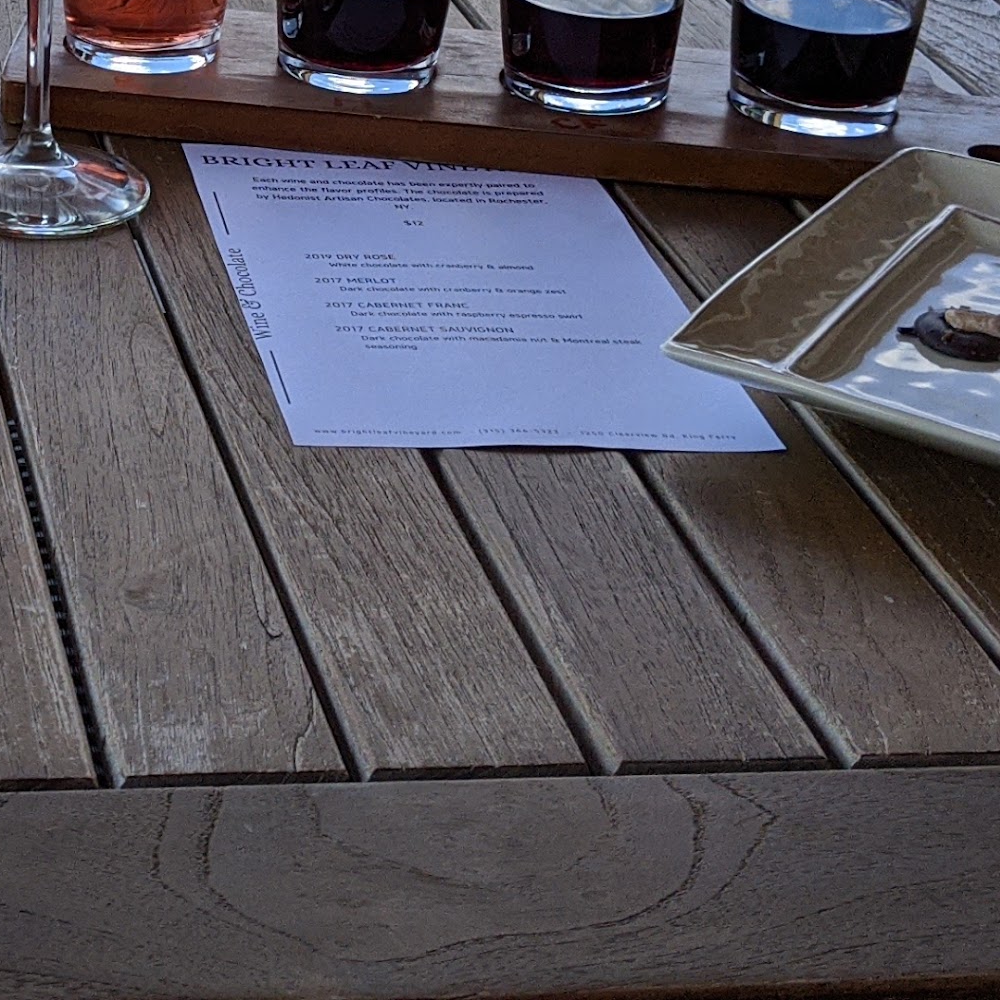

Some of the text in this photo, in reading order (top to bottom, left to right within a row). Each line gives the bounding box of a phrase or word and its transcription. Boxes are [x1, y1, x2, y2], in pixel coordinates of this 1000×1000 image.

[200, 155, 506, 172] BRIGHT LEAF VINE
[252, 176, 279, 184] Each
[332, 178, 384, 187] chocolate
[386, 180, 406, 188] has
[438, 181, 483, 190] expertly
[485, 181, 520, 190] paired
[252, 185, 297, 193] enhance
[321, 186, 352, 194] flavor
[403, 188, 424, 196] The
[427, 188, 480, 197] chocolate
[482, 189, 492, 197] is
[494, 190, 545, 199] prepared
[272, 193, 321, 202] Hedonist
[324, 194, 364, 203] Artisan
[432, 196, 473, 204] located
[475, 197, 487, 205] in
[328, 261, 358, 269] White
[227, 248, 273, 341] Wine & Chocolate
[339, 285, 363, 293] Dark
[506, 288, 543, 296] orange
[545, 288, 567, 296] zest
[427, 302, 470, 310] FRANC
[455, 311, 507, 320] raspberry
[508, 312, 556, 320] espresso
[334, 325, 515, 334] 2017 CABERNET SAUVIGNON
[468, 336, 528, 344] macadamia
